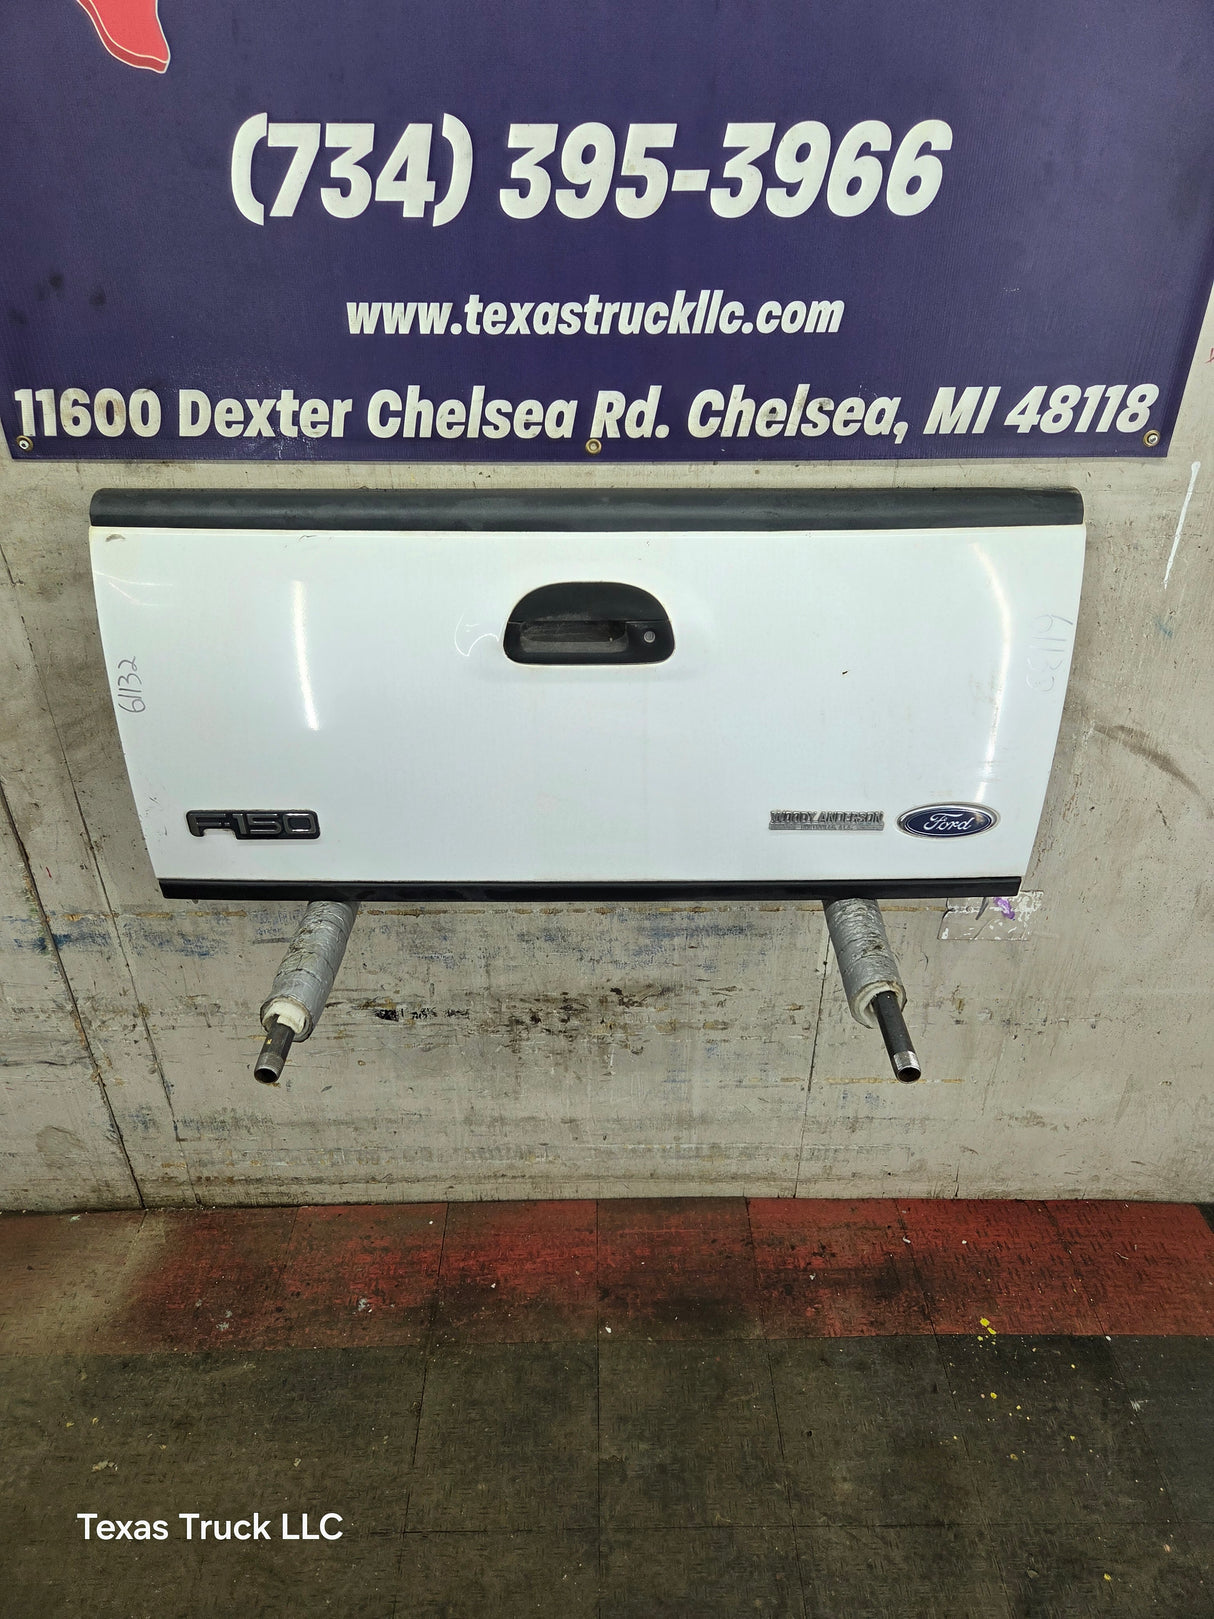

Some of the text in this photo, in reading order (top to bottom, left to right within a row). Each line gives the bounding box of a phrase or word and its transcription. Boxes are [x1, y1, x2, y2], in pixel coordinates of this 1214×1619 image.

[231, 112, 953, 226] (734) 395-3966
[346, 289, 845, 335] www.texastruckllc.com
[14, 383, 1160, 444] 11600 Dexter Chelsea Rd. Chelsea, MI 48118
[117, 655, 146, 713] 61132
[187, 811, 319, 838] F-150
[770, 810, 884, 823] WOODY ANDERSON
[923, 812, 975, 831] Ford
